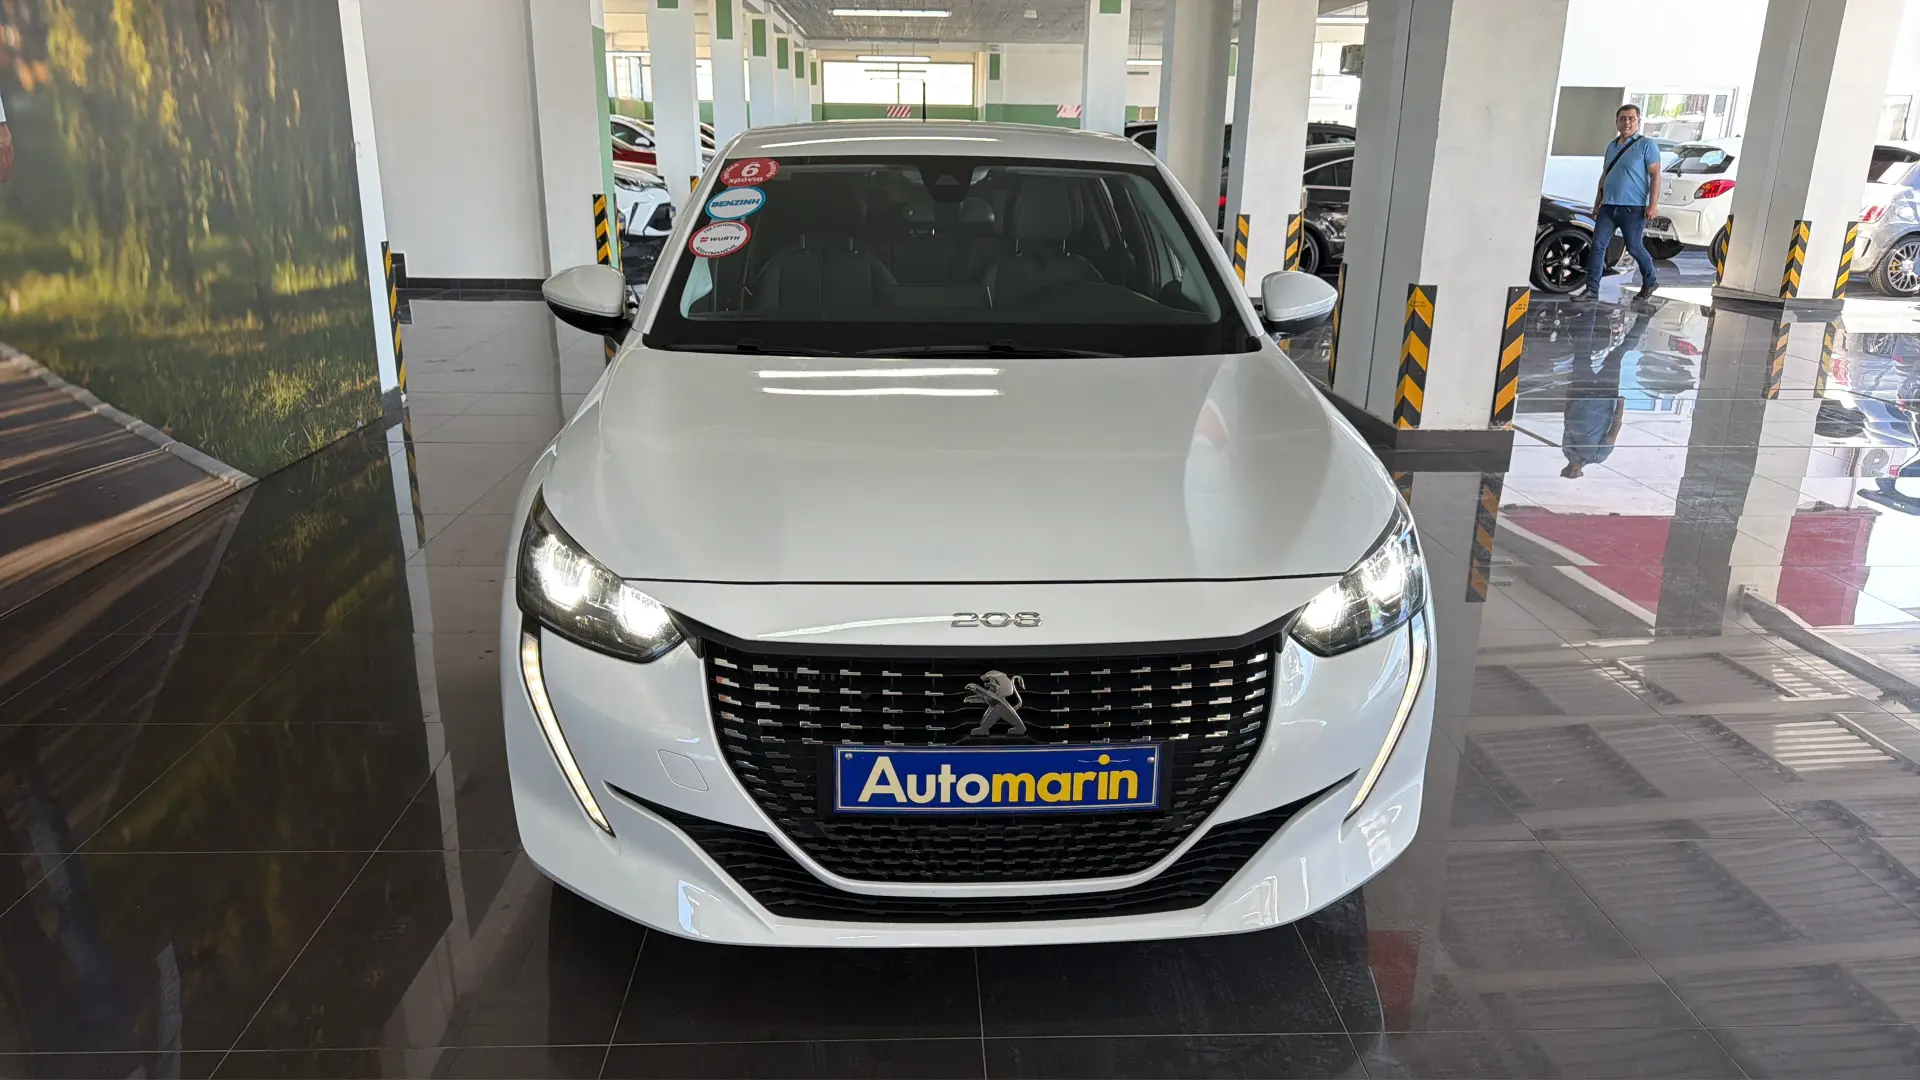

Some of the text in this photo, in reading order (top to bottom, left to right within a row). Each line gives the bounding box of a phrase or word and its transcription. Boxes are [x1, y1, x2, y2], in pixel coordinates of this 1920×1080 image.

[741, 163, 761, 177] 6
[728, 176, 763, 184] χρόνια
[951, 611, 1042, 628] 208
[857, 753, 1138, 804] Automarin
